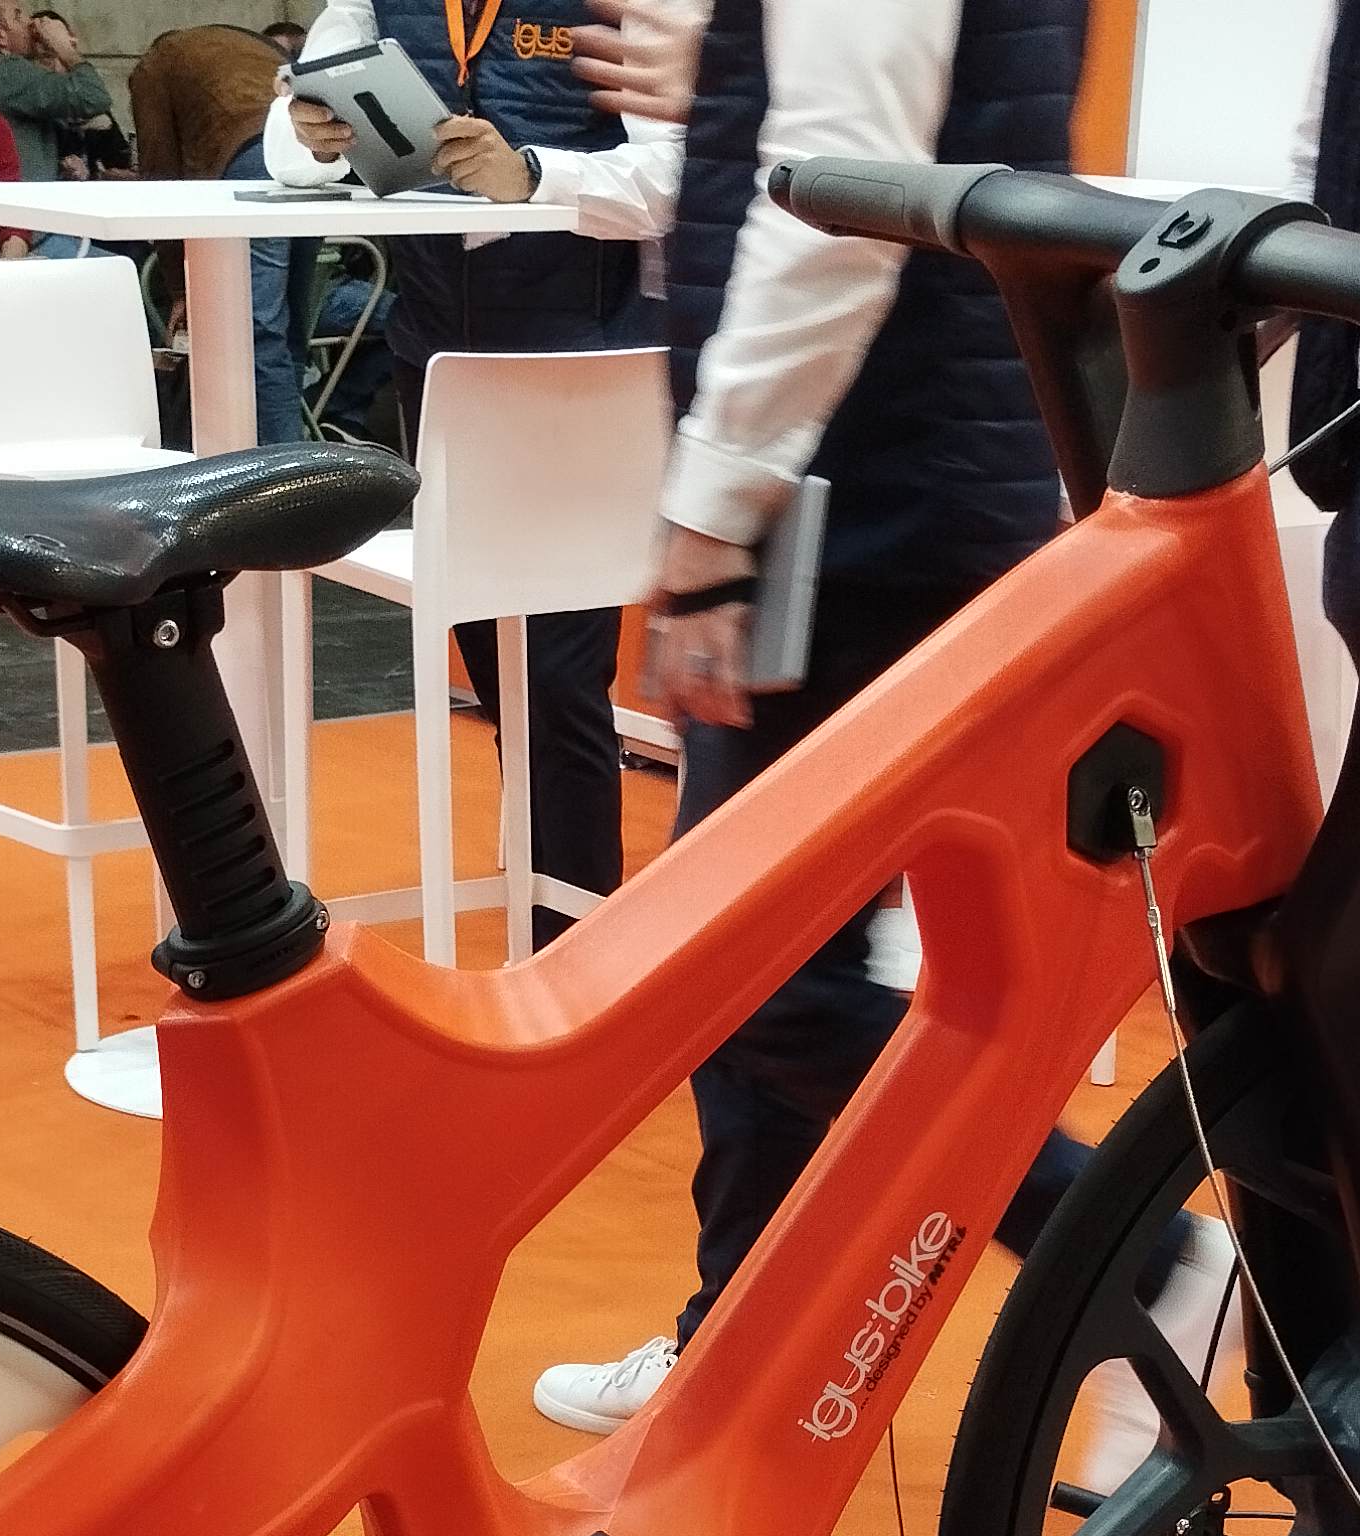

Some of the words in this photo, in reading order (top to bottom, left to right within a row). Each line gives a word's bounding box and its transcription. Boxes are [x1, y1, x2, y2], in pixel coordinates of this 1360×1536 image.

[513, 18, 574, 59] igus
[866, 1308, 918, 1392] designed
[911, 1285, 933, 1311] by
